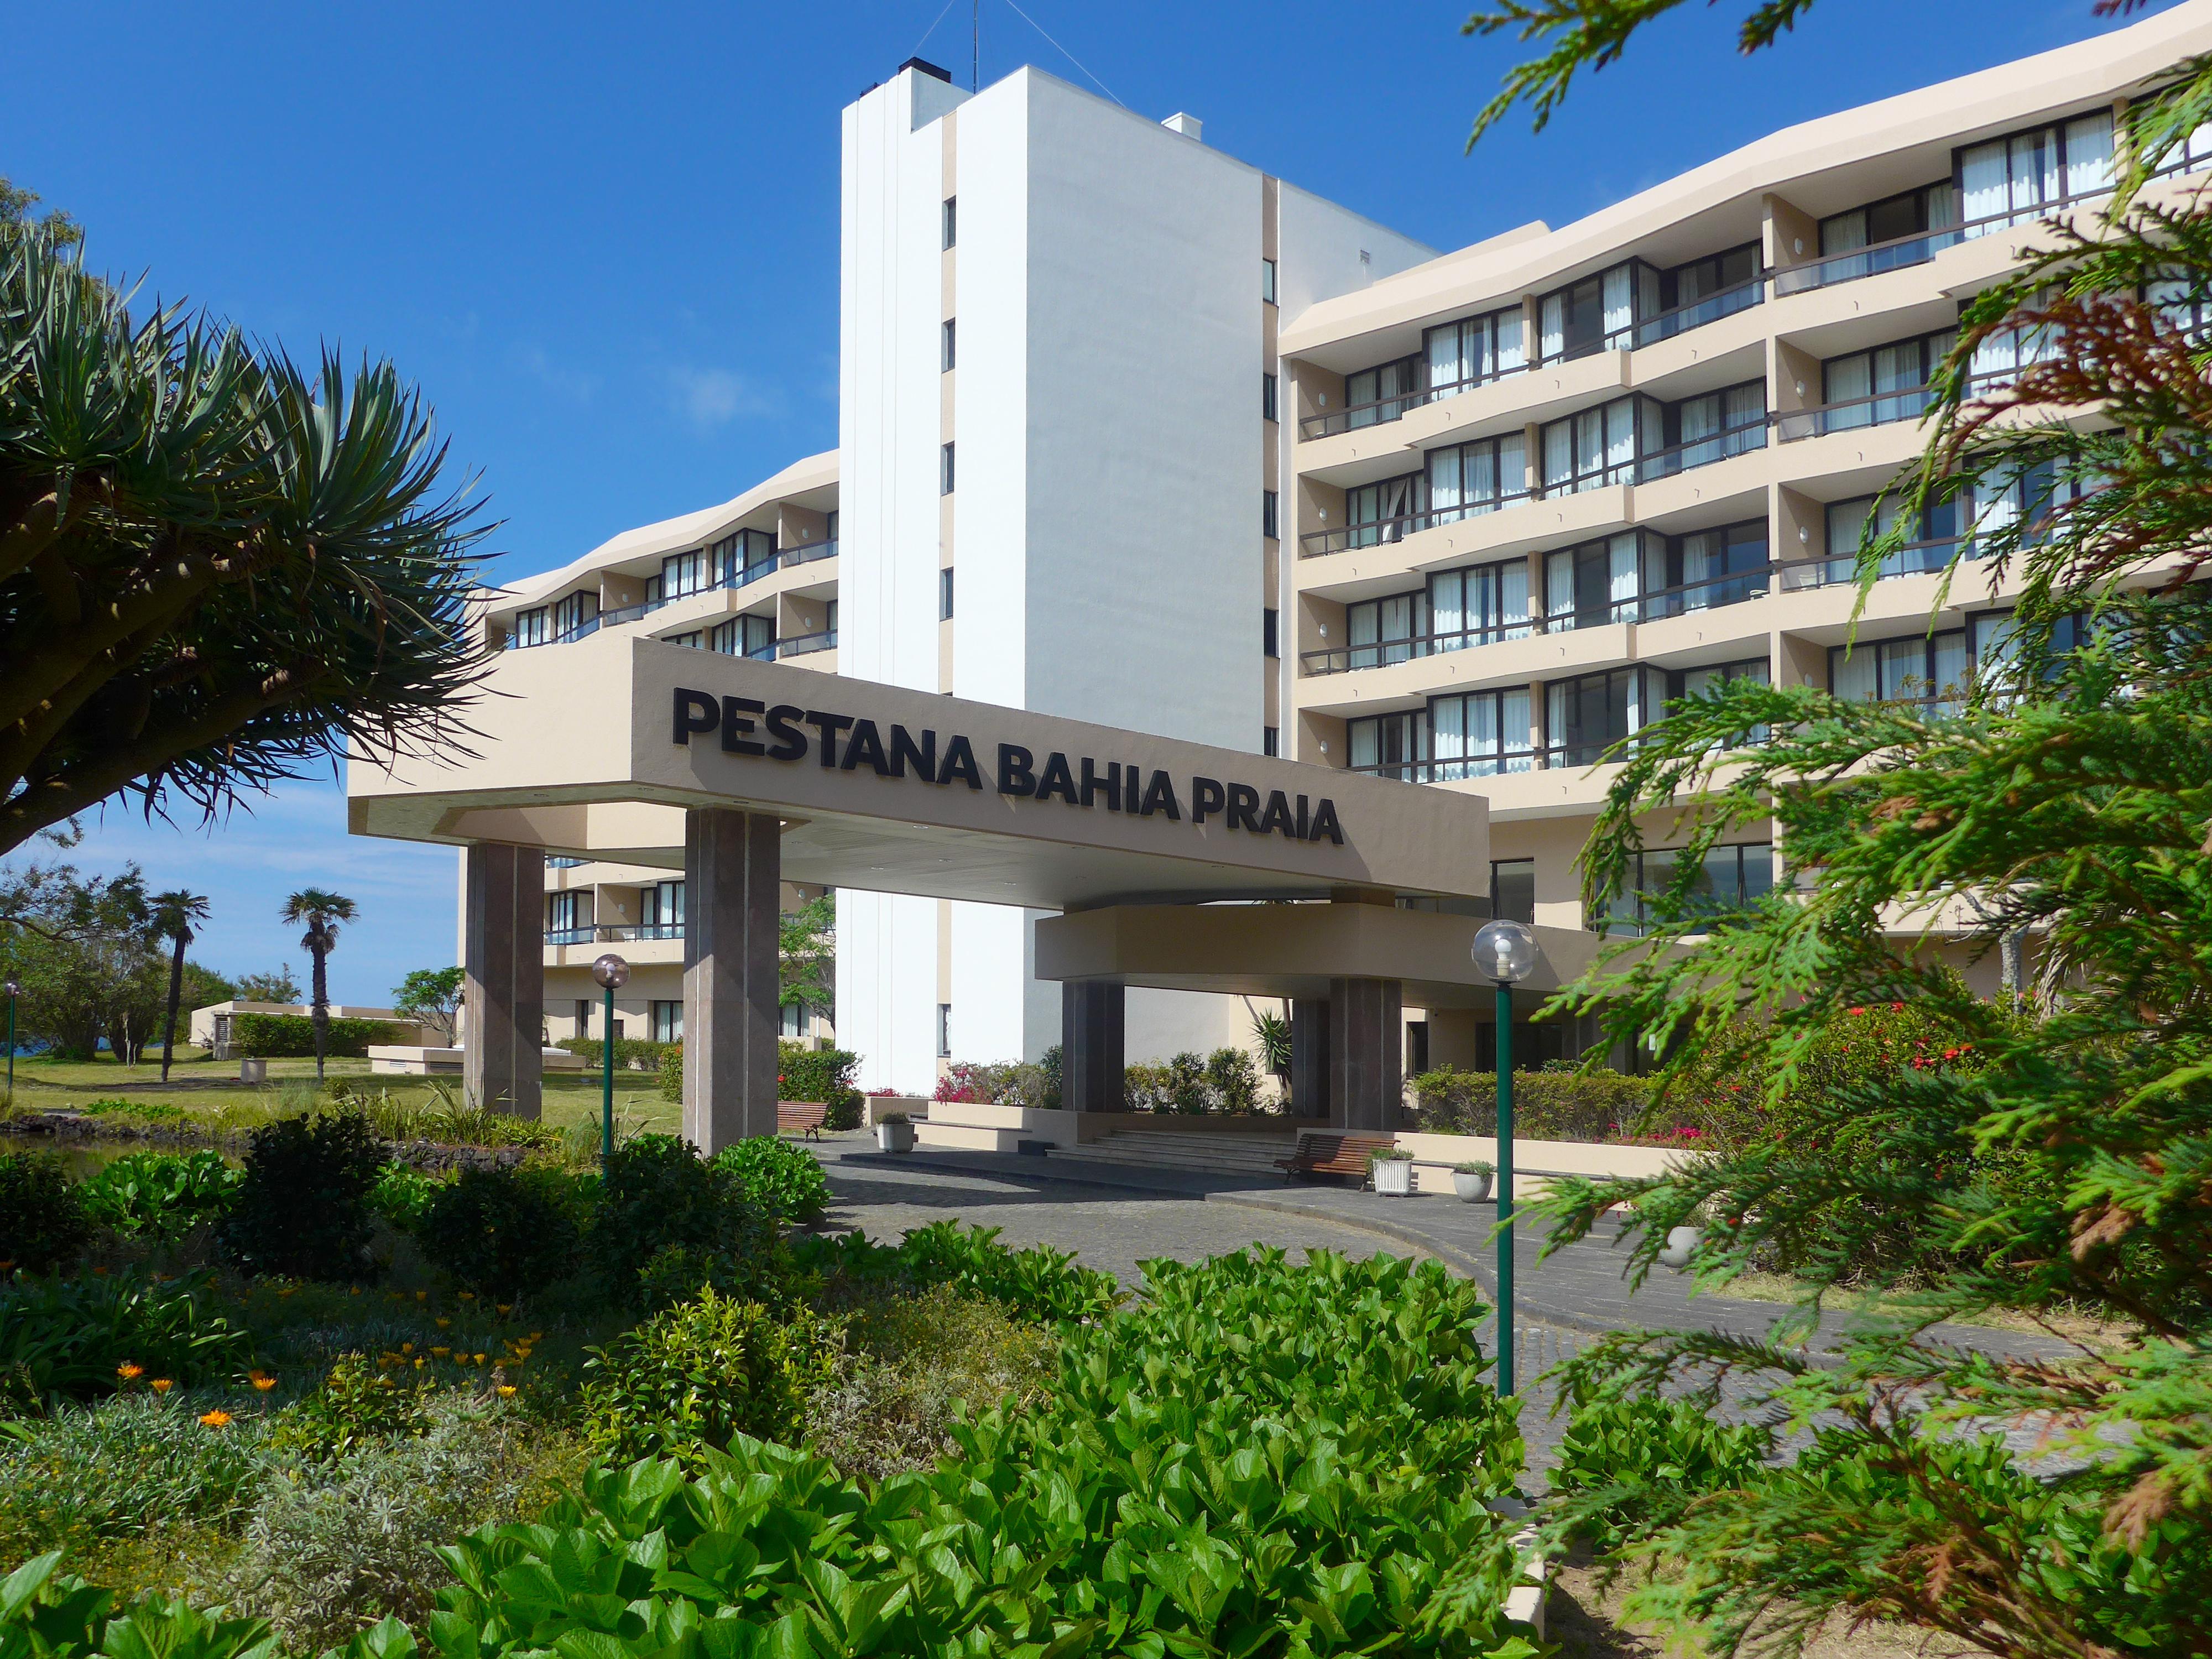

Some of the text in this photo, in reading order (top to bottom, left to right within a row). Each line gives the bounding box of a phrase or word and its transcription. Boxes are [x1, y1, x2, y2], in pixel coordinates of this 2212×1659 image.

[673, 687, 1344, 845] PESTANA BAHIA PRAIA
